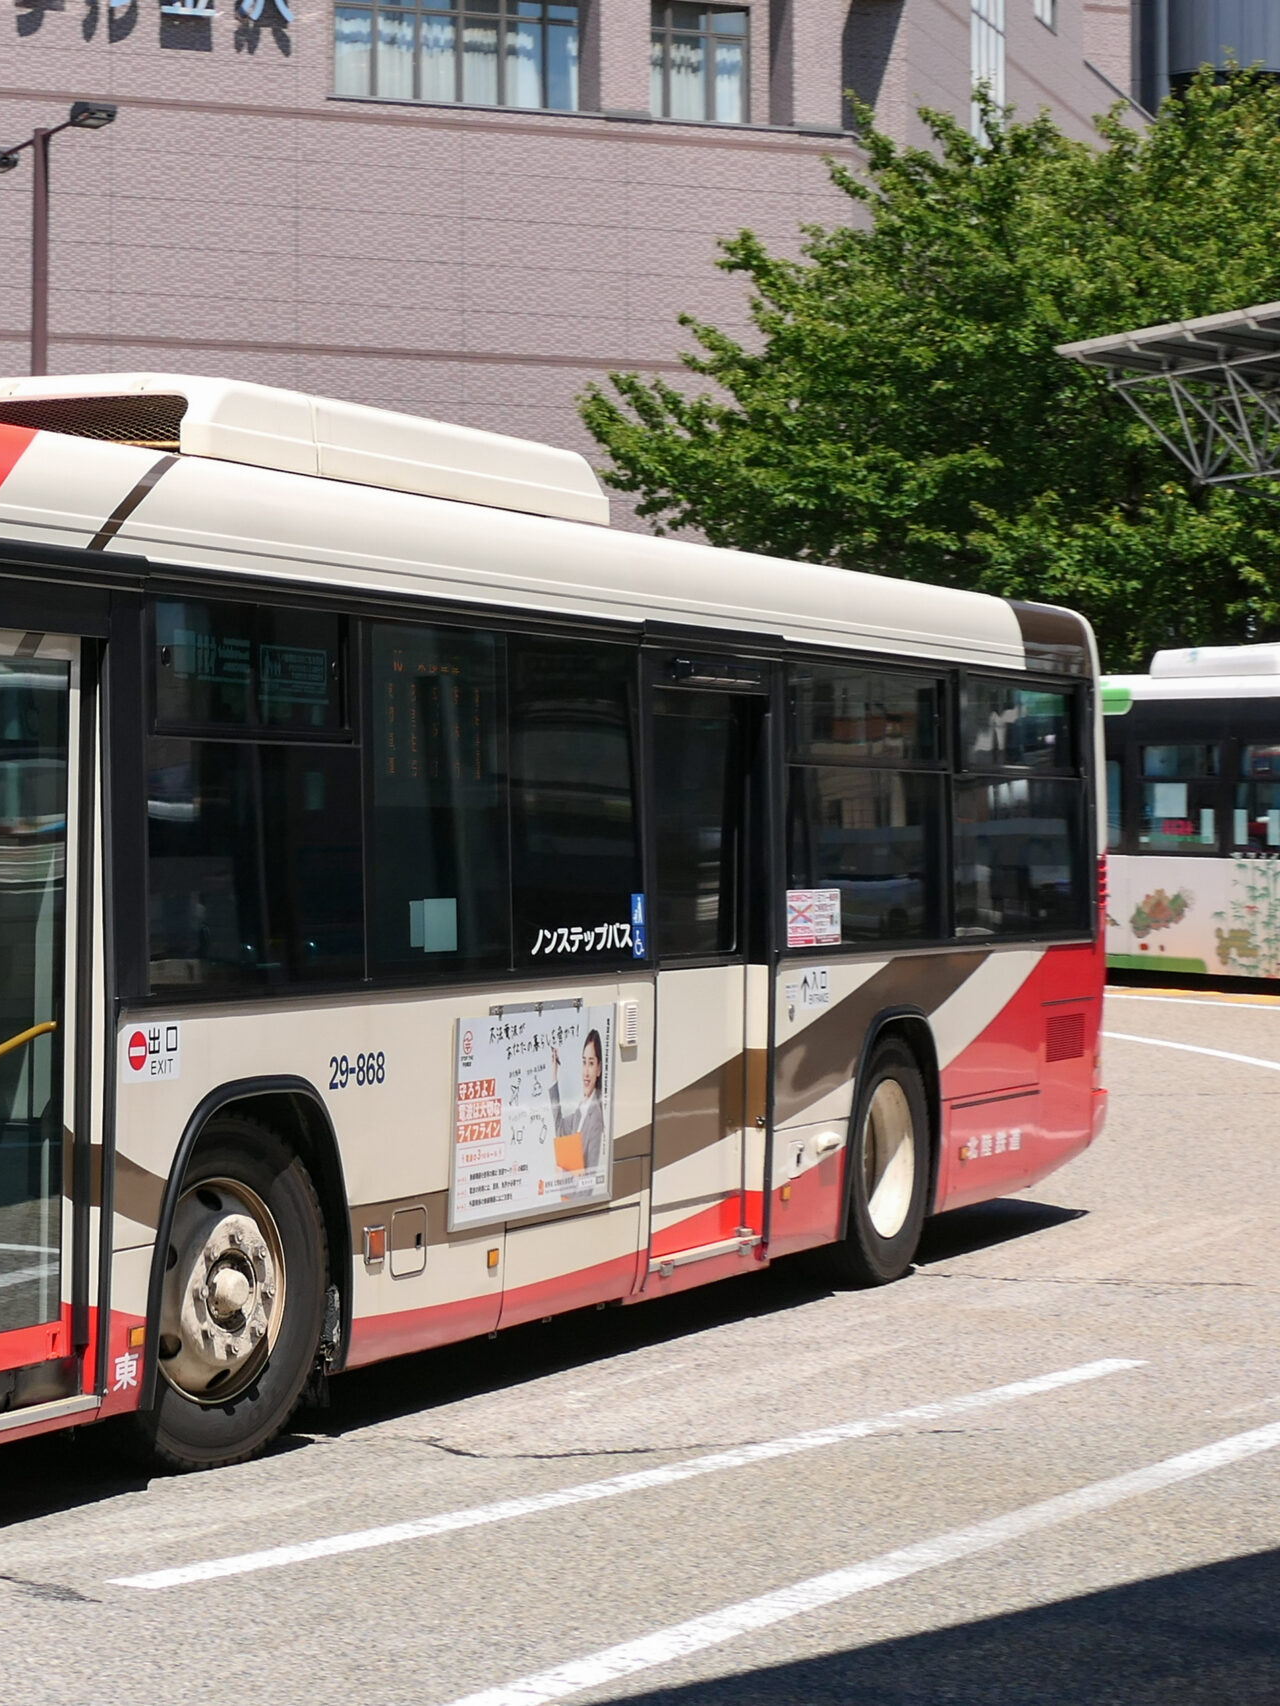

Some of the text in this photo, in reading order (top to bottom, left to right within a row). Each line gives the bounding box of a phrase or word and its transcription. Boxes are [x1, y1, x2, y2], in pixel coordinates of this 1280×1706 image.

[530, 922, 633, 956] ノンステップバス
[148, 1026, 178, 1054] 出口
[150, 1058, 174, 1076] EXIT
[329, 1051, 385, 1090] 29-868
[458, 1079, 495, 1100] 守ろうよ！
[457, 1121, 501, 1142] ライフライン
[113, 1352, 139, 1392] 東
